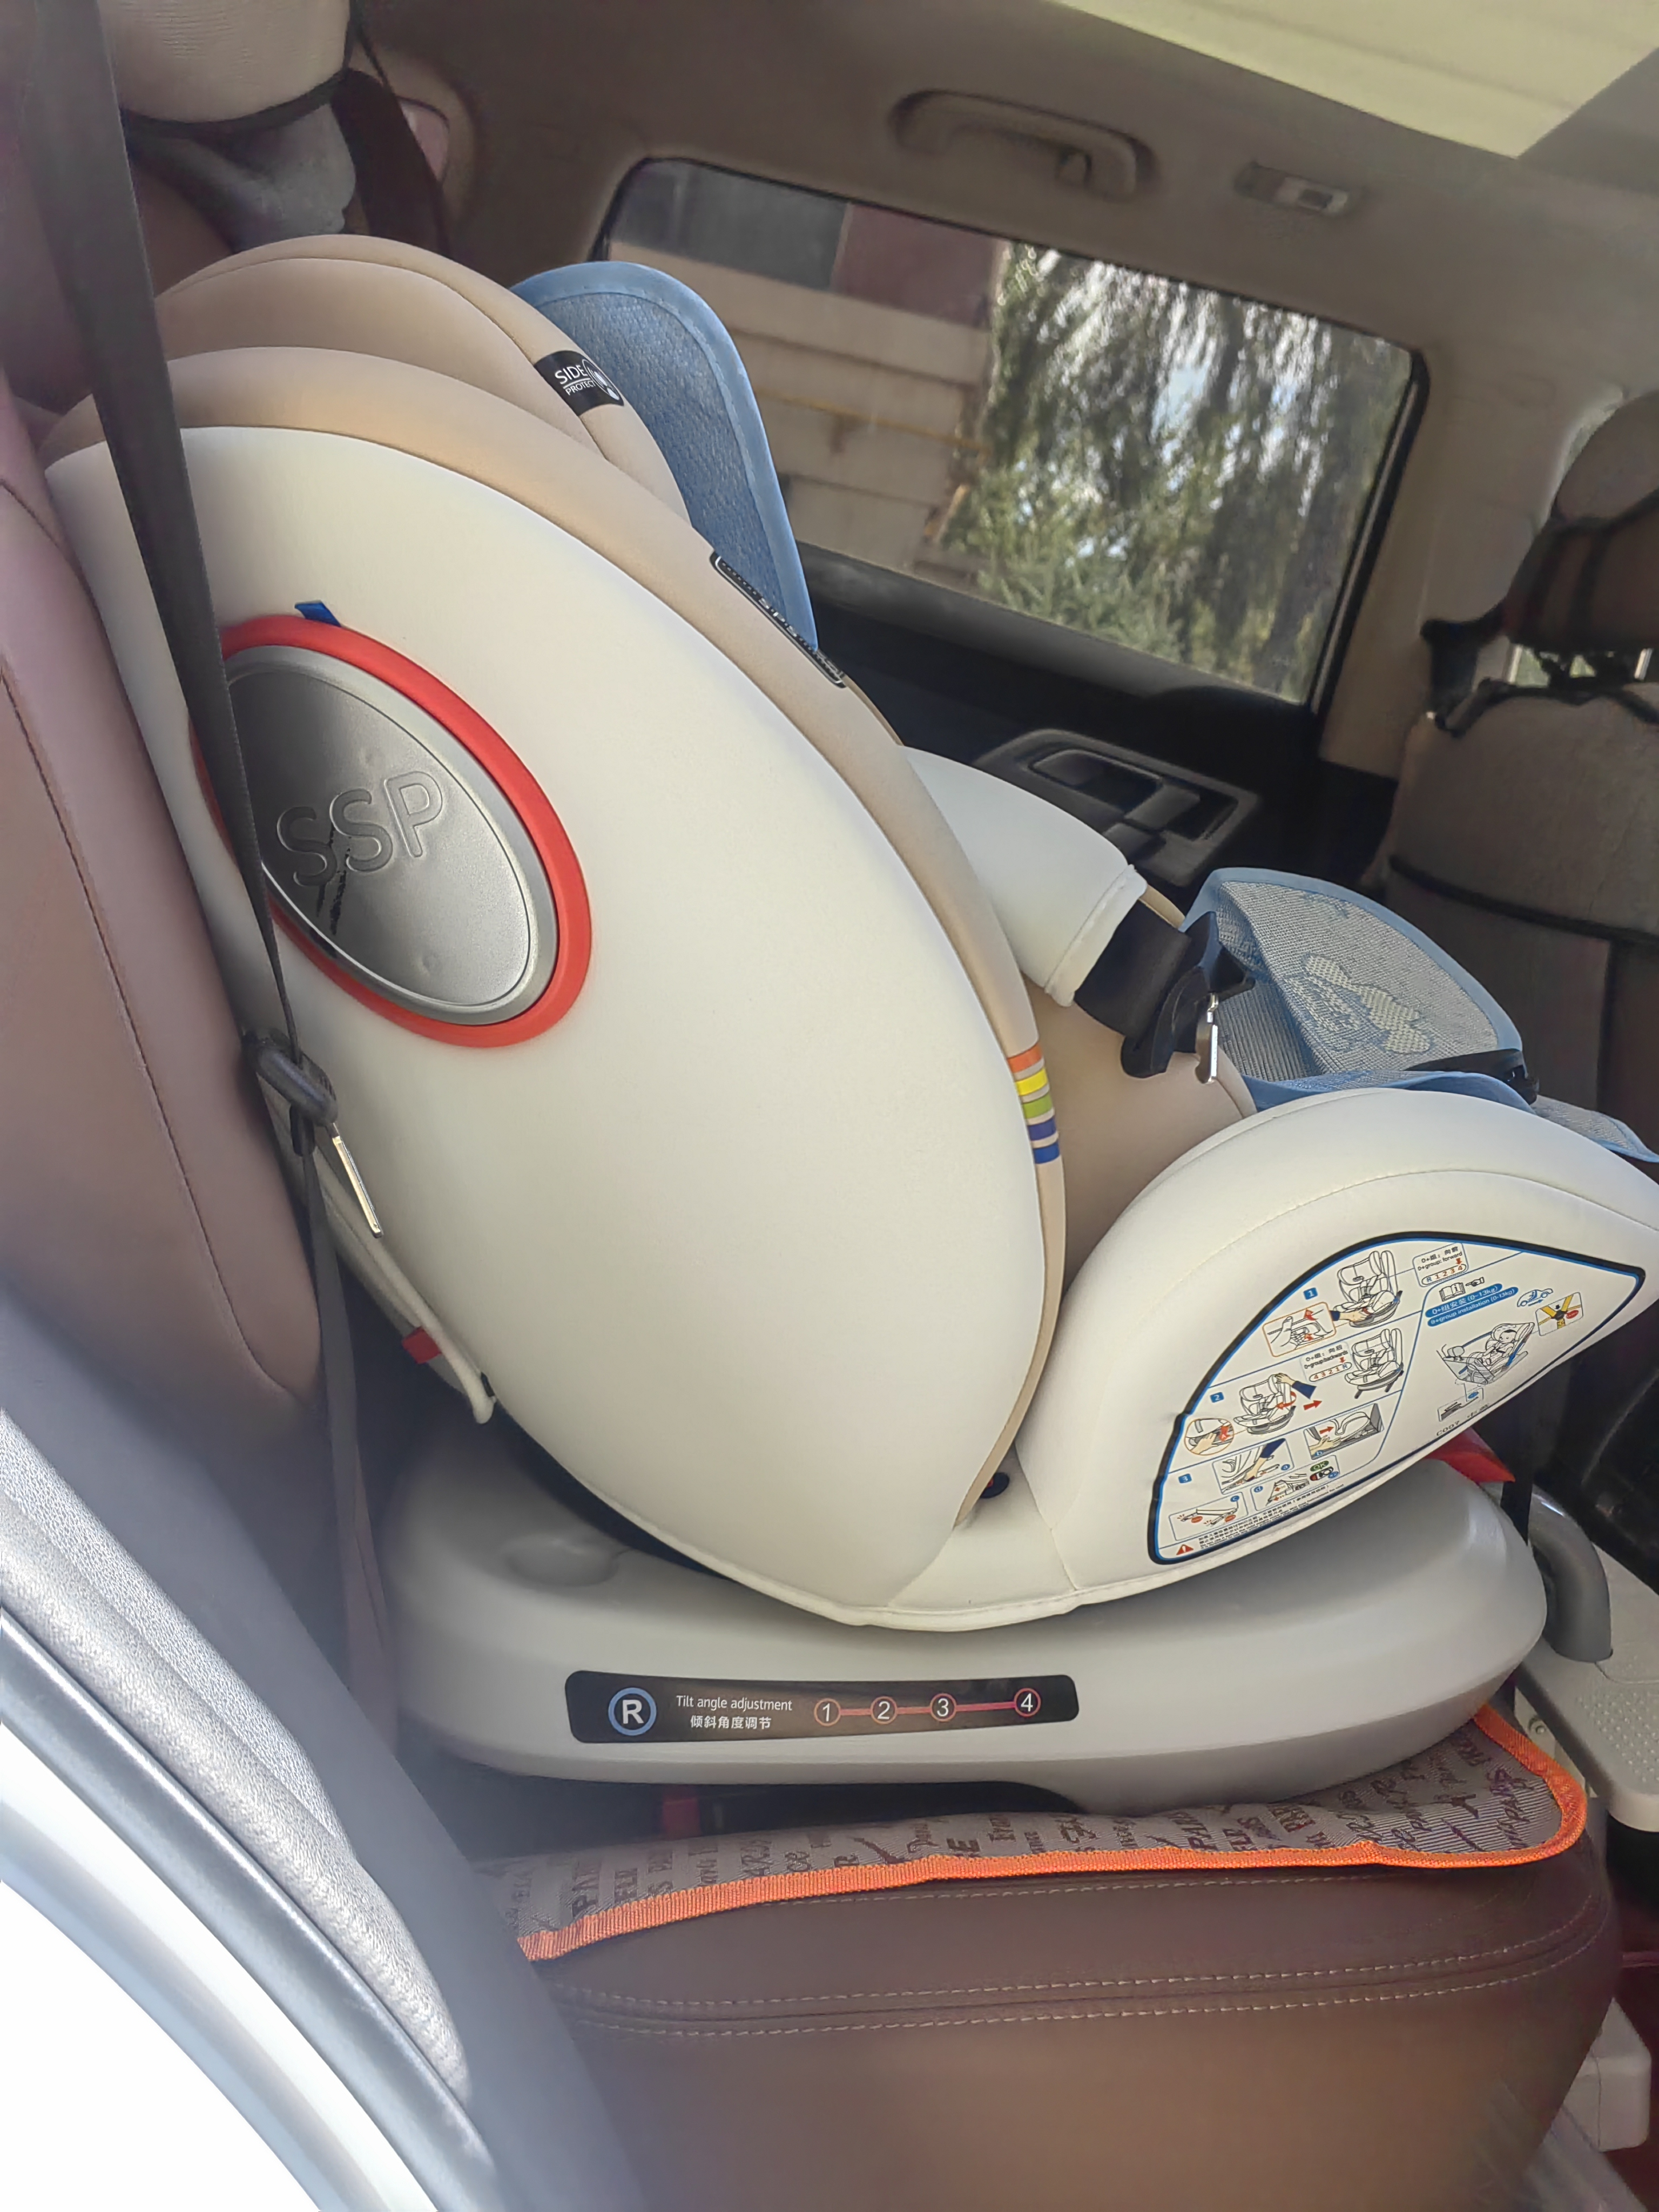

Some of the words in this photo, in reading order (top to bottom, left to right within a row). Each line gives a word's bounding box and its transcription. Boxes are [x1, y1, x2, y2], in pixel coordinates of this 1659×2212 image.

[555, 365, 588, 385] SIDE
[276, 771, 443, 887] SSP
[1442, 1251, 1463, 1263] forward
[1458, 1298, 1491, 1314] installation
[1313, 1461, 1326, 1471] OK
[622, 1699, 644, 1724] R
[676, 1695, 694, 1707] Tilt
[697, 1697, 728, 1711] angle
[730, 1697, 793, 1712] adjustment
[876, 1701, 891, 1720] 2
[936, 1698, 949, 1717] 3
[1020, 1692, 1034, 1712] 4
[690, 1715, 772, 1730] 倾斜角度调节
